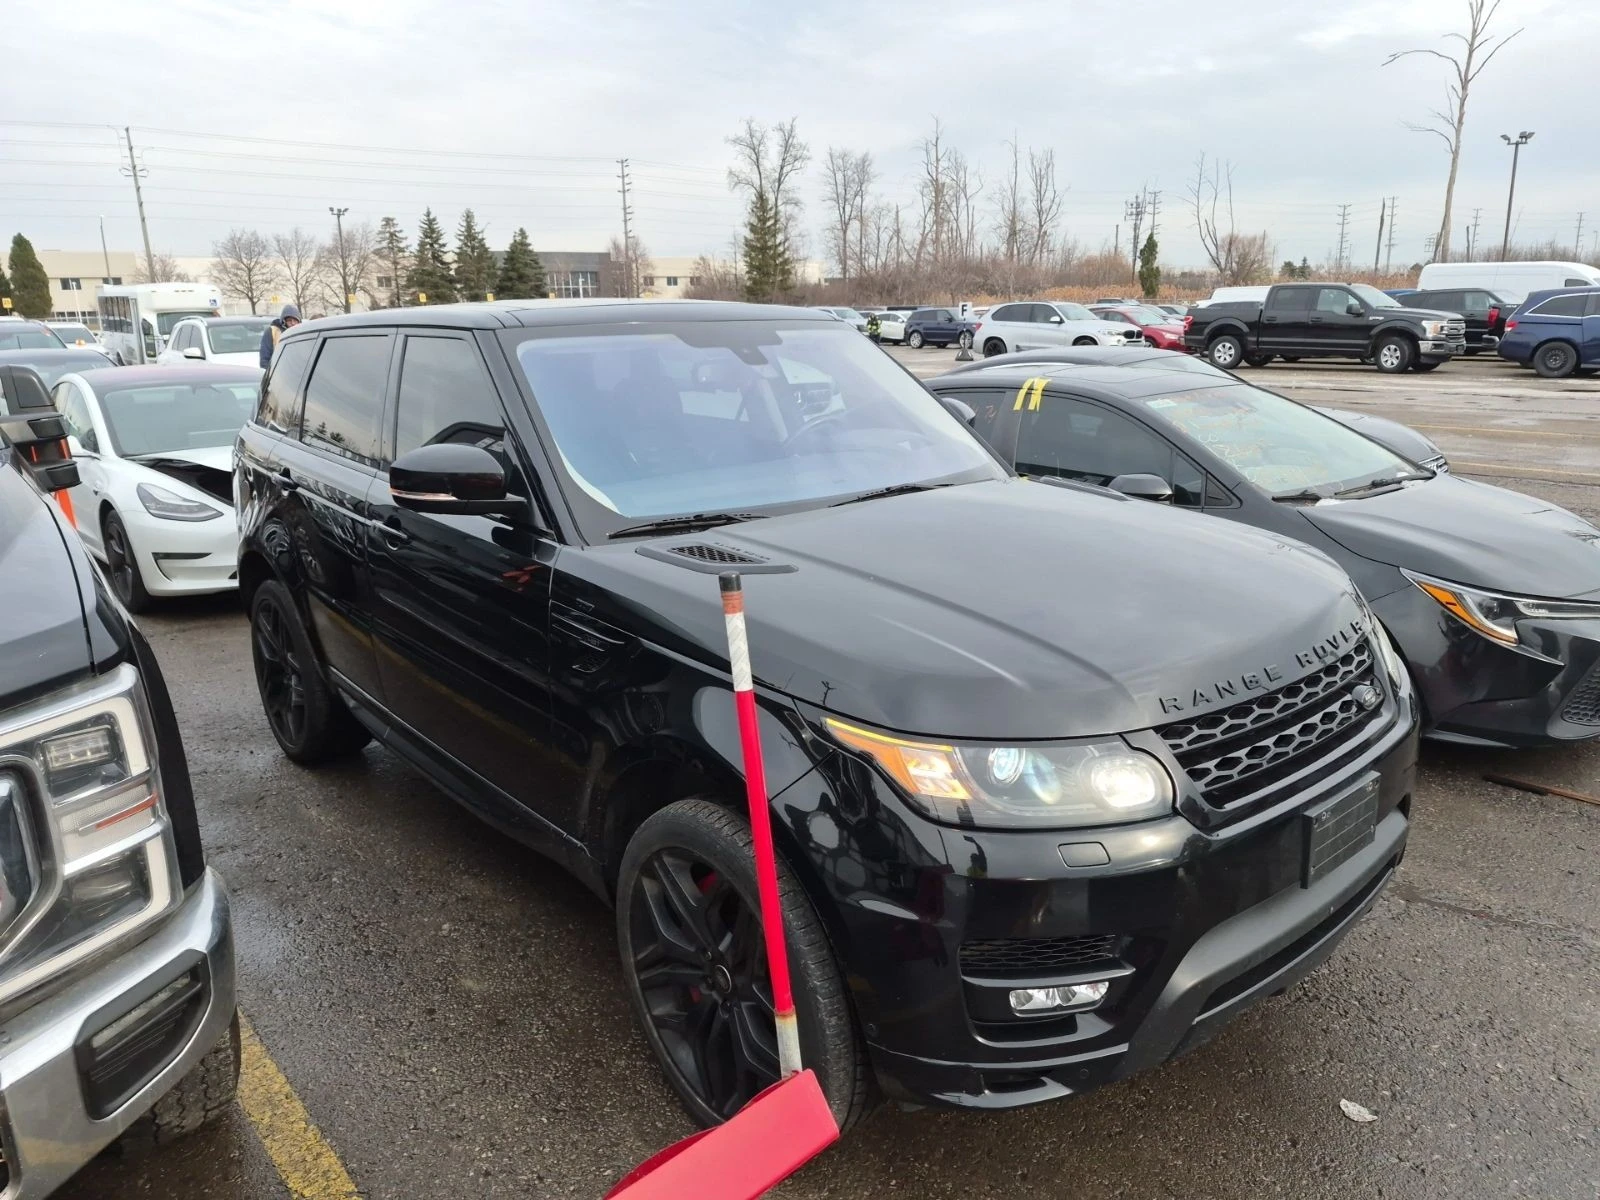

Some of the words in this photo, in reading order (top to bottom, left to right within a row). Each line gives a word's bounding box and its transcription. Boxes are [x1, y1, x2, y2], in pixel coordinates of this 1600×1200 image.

[961, 303, 968, 317] F
[1158, 663, 1284, 715] RANGE
[1295, 617, 1365, 669] ROVER
